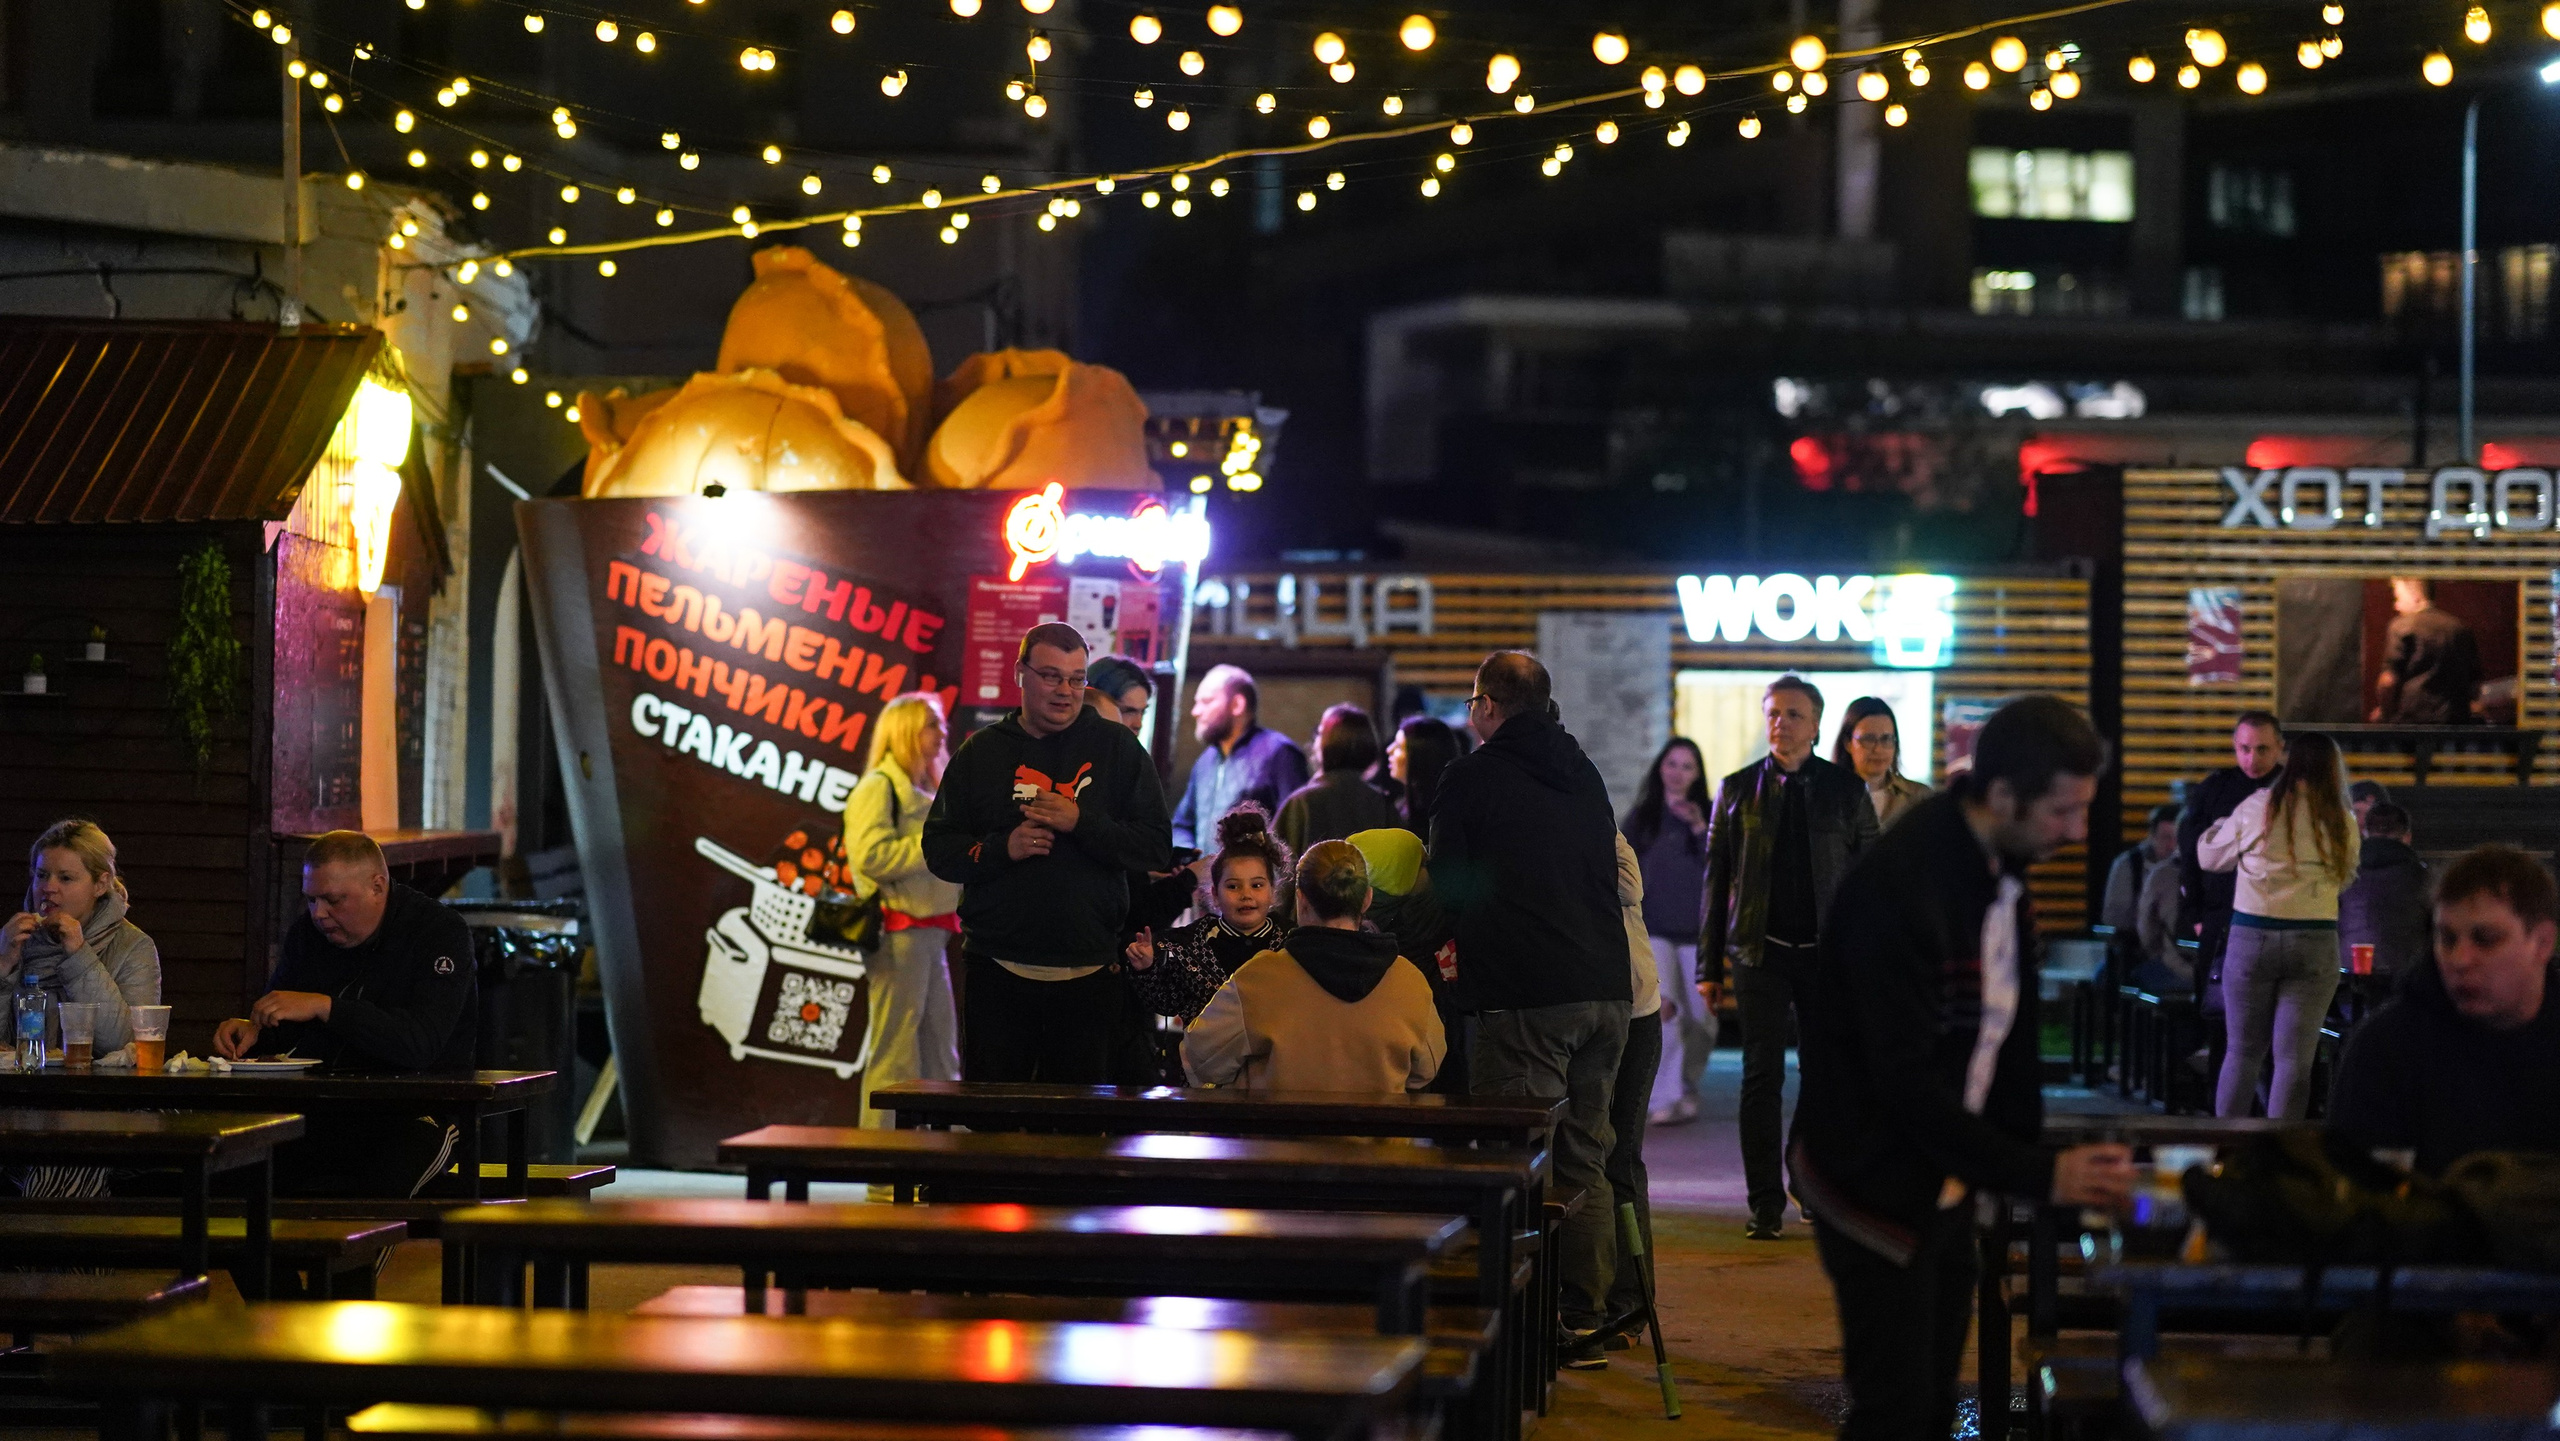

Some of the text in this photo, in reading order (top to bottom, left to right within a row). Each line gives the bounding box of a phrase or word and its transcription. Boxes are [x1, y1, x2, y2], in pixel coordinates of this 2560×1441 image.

[2221, 467, 2560, 540] ХОТ ДО
[607, 560, 908, 703] ПЕЛЬМЕНИ
[641, 511, 945, 654] ЖАРЕНЫЕ
[1676, 572, 1876, 643] WOK
[614, 625, 867, 753] ПОНЧИКИ
[631, 692, 859, 813] СТАКАНЕ
